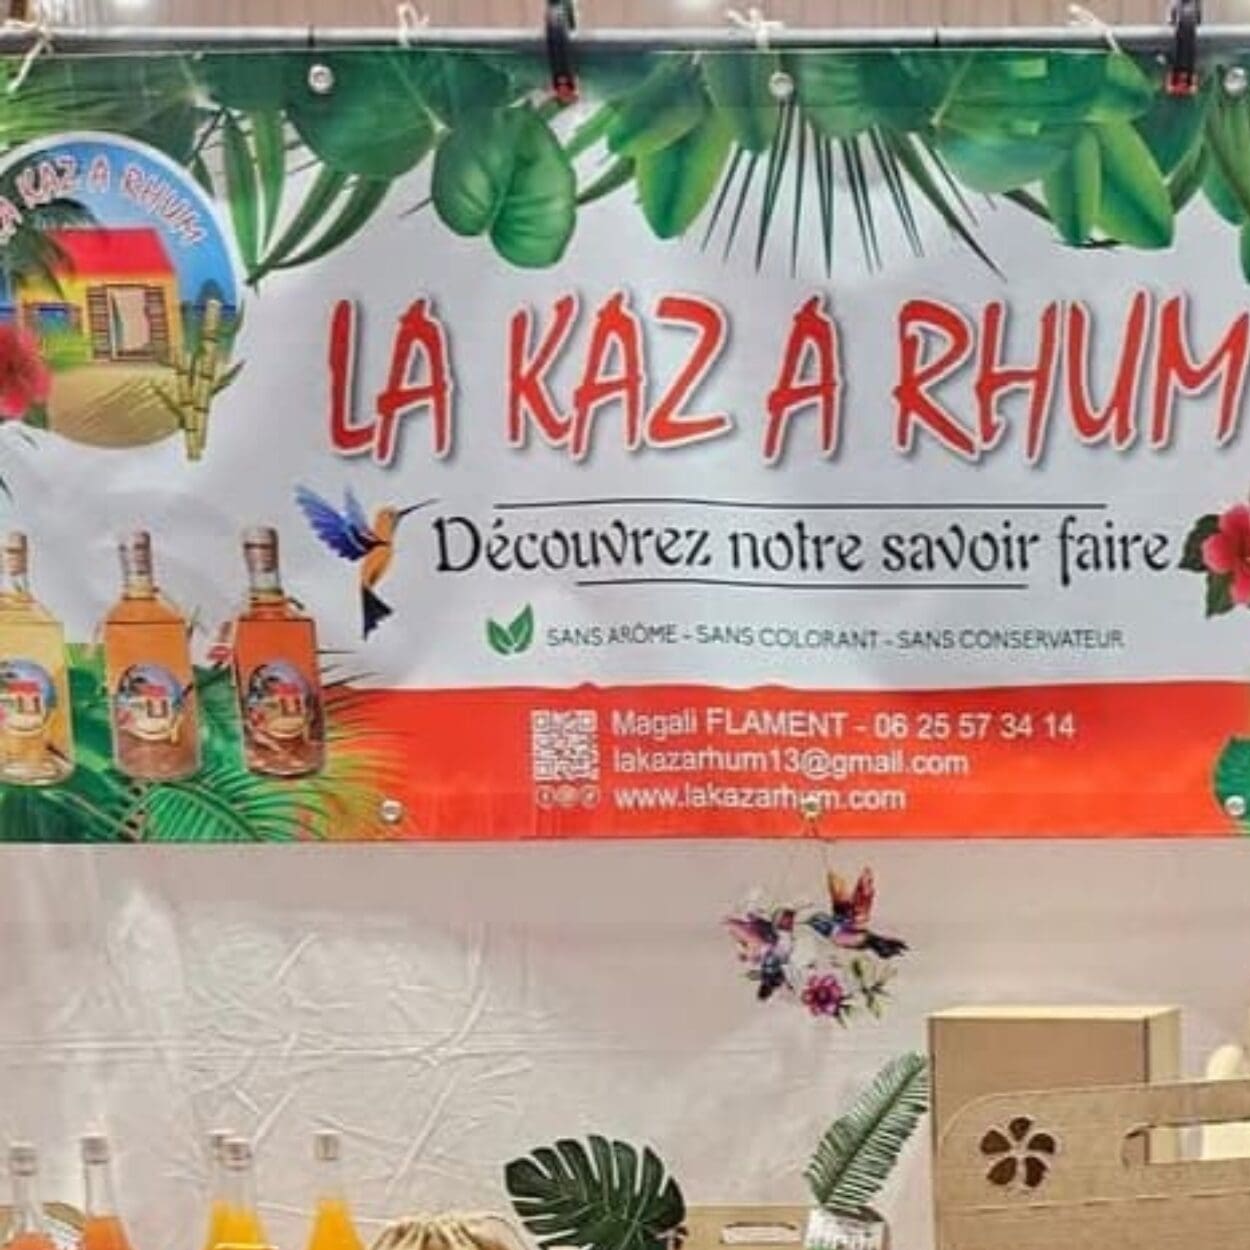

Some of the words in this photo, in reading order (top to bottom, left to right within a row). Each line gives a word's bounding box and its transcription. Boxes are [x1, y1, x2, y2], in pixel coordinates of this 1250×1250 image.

[86, 153, 111, 193] A
[120, 162, 207, 245] RHUM
[328, 296, 453, 466] LA
[507, 293, 735, 464] KAZ
[765, 293, 842, 467] A
[432, 515, 713, 573] Découvrez
[728, 519, 866, 573] notre
[881, 519, 1041, 574] savoir
[1055, 514, 1172, 588] faire
[547, 627, 603, 648] SANS
[607, 621, 678, 645] ARÔME
[696, 625, 753, 646] SANS
[758, 626, 877, 649] COLORANT
[898, 630, 954, 650] SANS
[958, 628, 1124, 650] CONSERVATEUR
[611, 709, 698, 741] Magali
[706, 707, 848, 738] FLAMENT
[873, 711, 909, 740] 06
[916, 711, 950, 740] 25
[958, 711, 991, 740] 57
[1001, 711, 1033, 739] 34
[1043, 711, 1075, 739] 14
[613, 745, 970, 781] lakazarhum13@gmail.com
